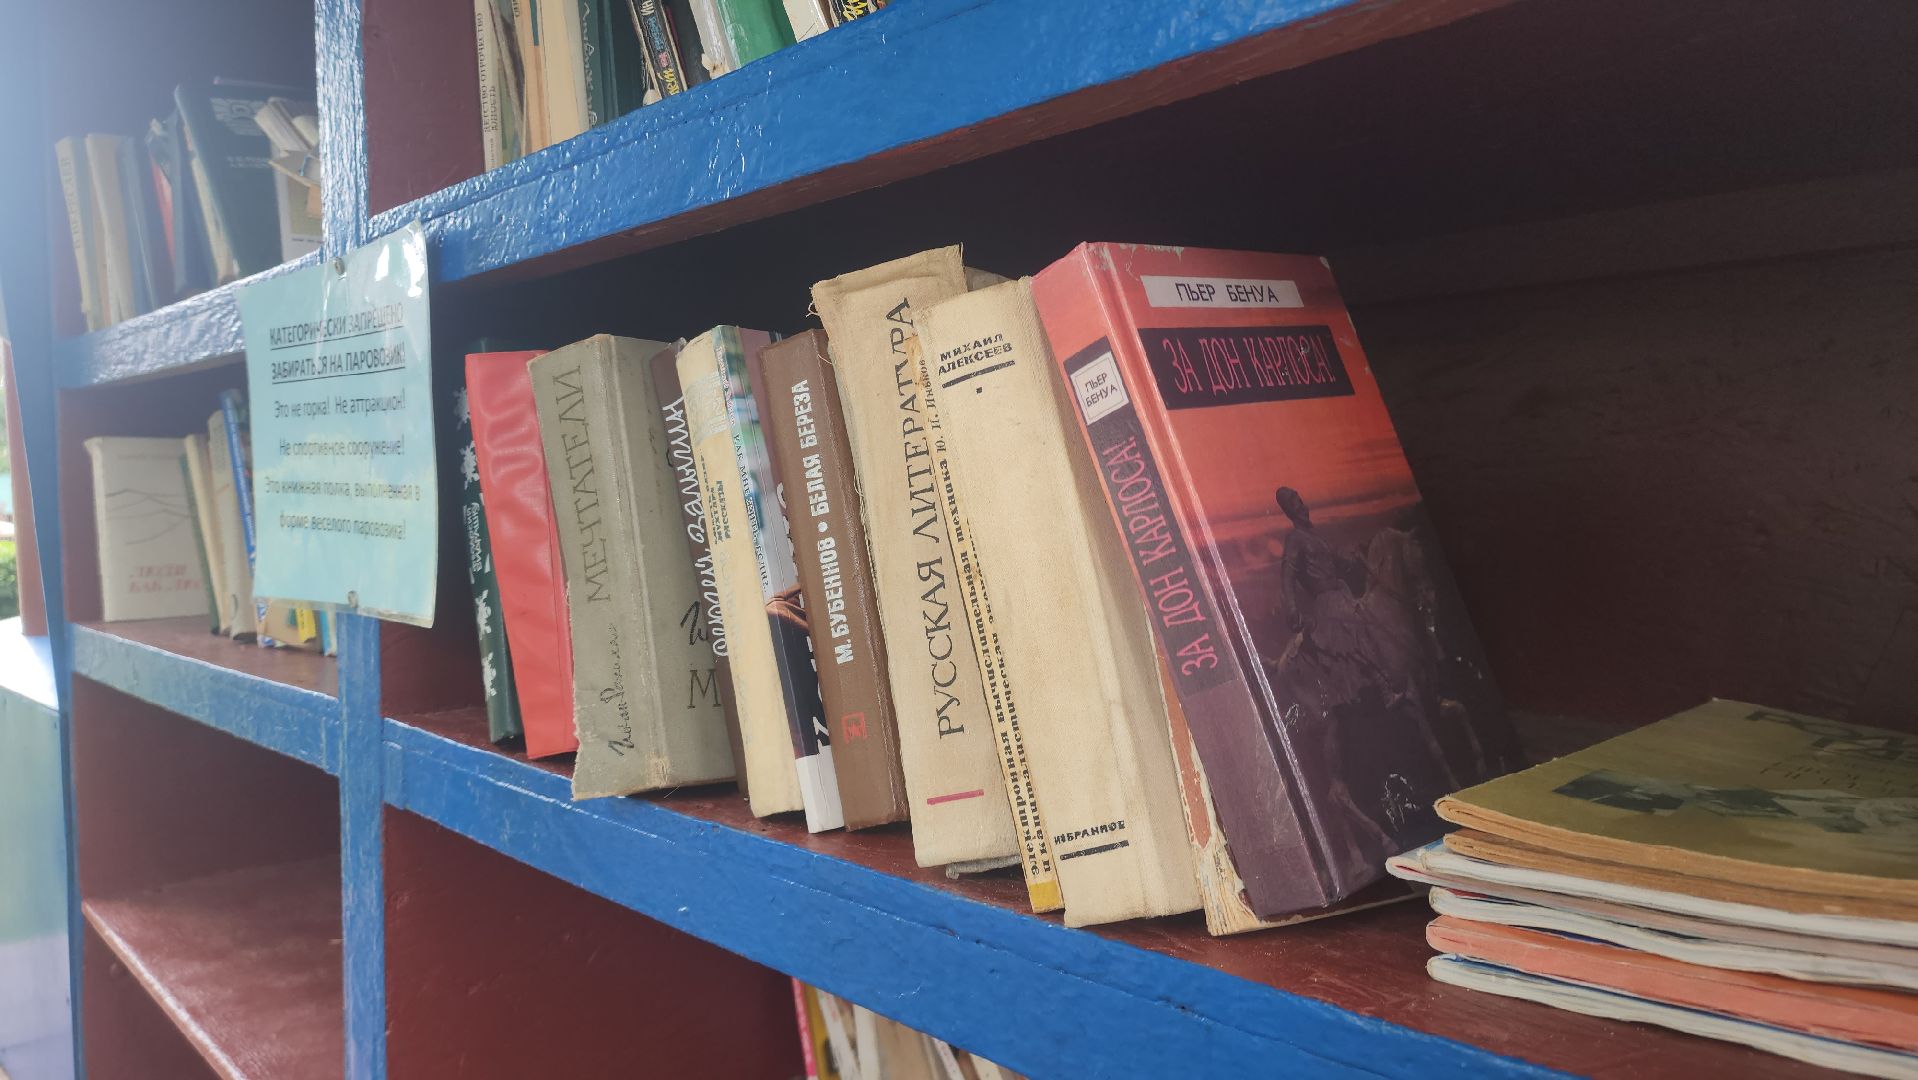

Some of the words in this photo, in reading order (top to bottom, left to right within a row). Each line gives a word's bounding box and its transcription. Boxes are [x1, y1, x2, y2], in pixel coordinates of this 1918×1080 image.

[1175, 282, 1216, 302] ПЬЕР
[1226, 284, 1279, 304] БЕНУА
[269, 315, 346, 346] КАТЕГОРИЧЕСКИ
[349, 302, 404, 333] ЗАПРЕЩЕНО
[271, 355, 328, 380] ЗАБИРАТЬСЯ
[329, 353, 344, 373] НА
[345, 341, 405, 372] ПАРОВОЗИК!
[937, 342, 1014, 377] АЛЕКСЕЕВ
[939, 332, 1004, 362] МИХАИЛ
[1163, 337, 1203, 394] ЗА
[1198, 337, 1252, 396] ДОН
[1245, 335, 1337, 389] КАРЛОСА!
[274, 400, 289, 419] Это
[291, 402, 301, 417] не
[303, 395, 330, 420] горка!
[334, 395, 348, 414] Не
[350, 387, 406, 416] аттракцион!
[1084, 371, 1108, 392] ПЬЕР
[1085, 383, 1118, 408] БЕНУА
[791, 379, 819, 450] БЕРЕЗА
[885, 297, 940, 543] ЛИТЕРАТУРА
[279, 436, 291, 455] Не
[292, 441, 345, 460] спортивное
[347, 433, 405, 460] сооружение!
[265, 475, 280, 494] Это
[281, 480, 321, 495] книжная
[354, 482, 413, 500] выполненная
[415, 484, 421, 502] в
[552, 363, 612, 603] МЕЧТАТЕЛИ
[802, 452, 830, 517] БЕЛАЯ
[939, 458, 966, 543] техника
[1102, 436, 1177, 567] КАРЛОСА!
[279, 509, 309, 533] форме
[311, 515, 351, 533] веселого
[353, 518, 406, 542] паровозика!
[817, 536, 850, 639] БУБЕННОВ
[1150, 566, 1207, 628] ДОН
[834, 638, 855, 665] М.
[916, 556, 965, 739] РУССКАЯ
[959, 551, 1006, 724] вычислительная
[1176, 632, 1218, 676] ЗА
[1000, 731, 1041, 877] электронная
